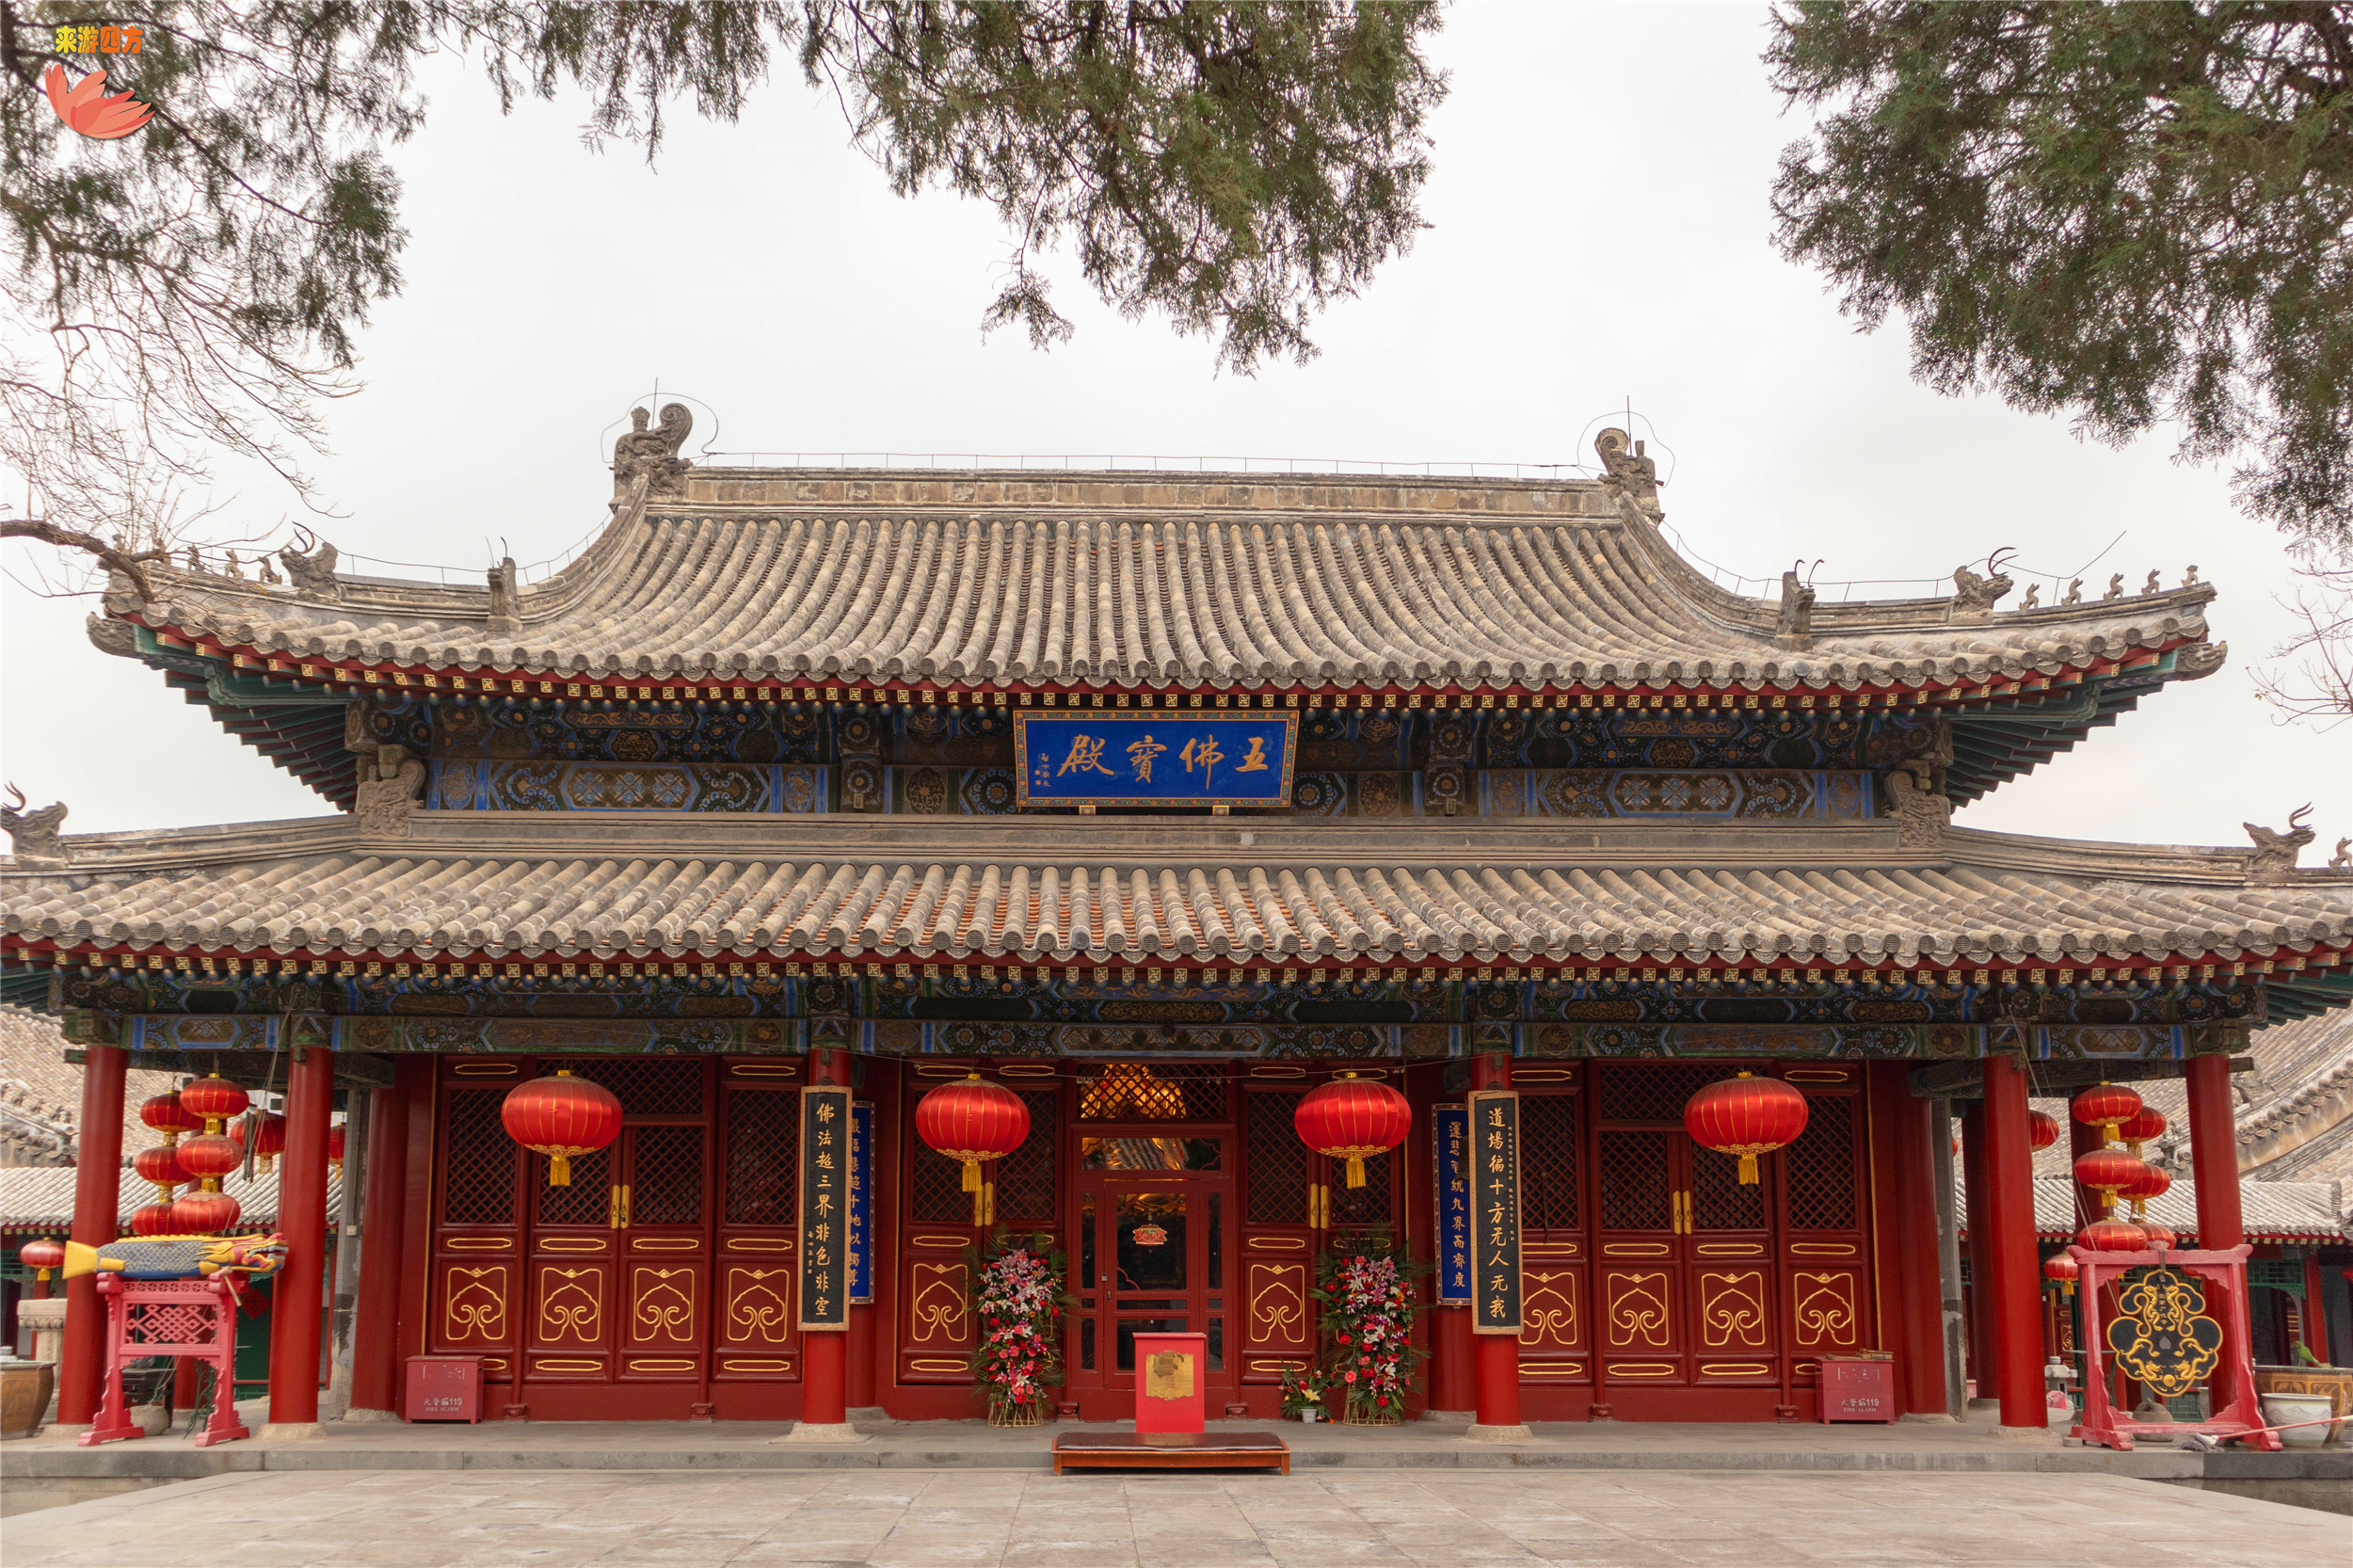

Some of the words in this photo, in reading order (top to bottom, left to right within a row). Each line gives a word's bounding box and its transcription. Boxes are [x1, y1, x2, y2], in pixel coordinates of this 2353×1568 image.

[1057, 734, 1269, 790] 五佛寶殿
[814, 1102, 835, 1316] 佛法超三界非色非空
[449, 1397, 462, 1406] 119
[1866, 1398, 1879, 1406] 119
